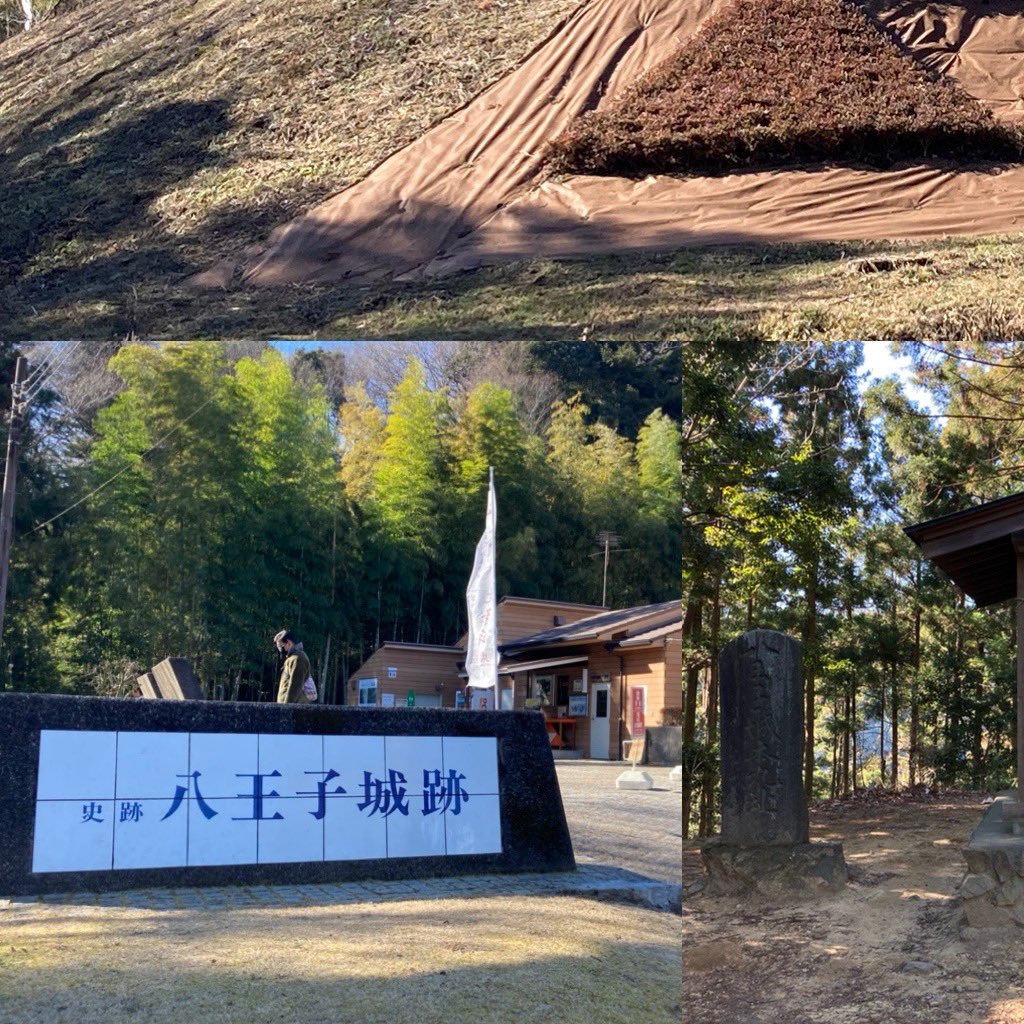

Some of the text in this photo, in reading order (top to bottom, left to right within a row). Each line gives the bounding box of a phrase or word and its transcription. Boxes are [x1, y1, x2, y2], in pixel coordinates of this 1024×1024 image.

[81, 769, 470, 824] 史跡 八王子城跡
